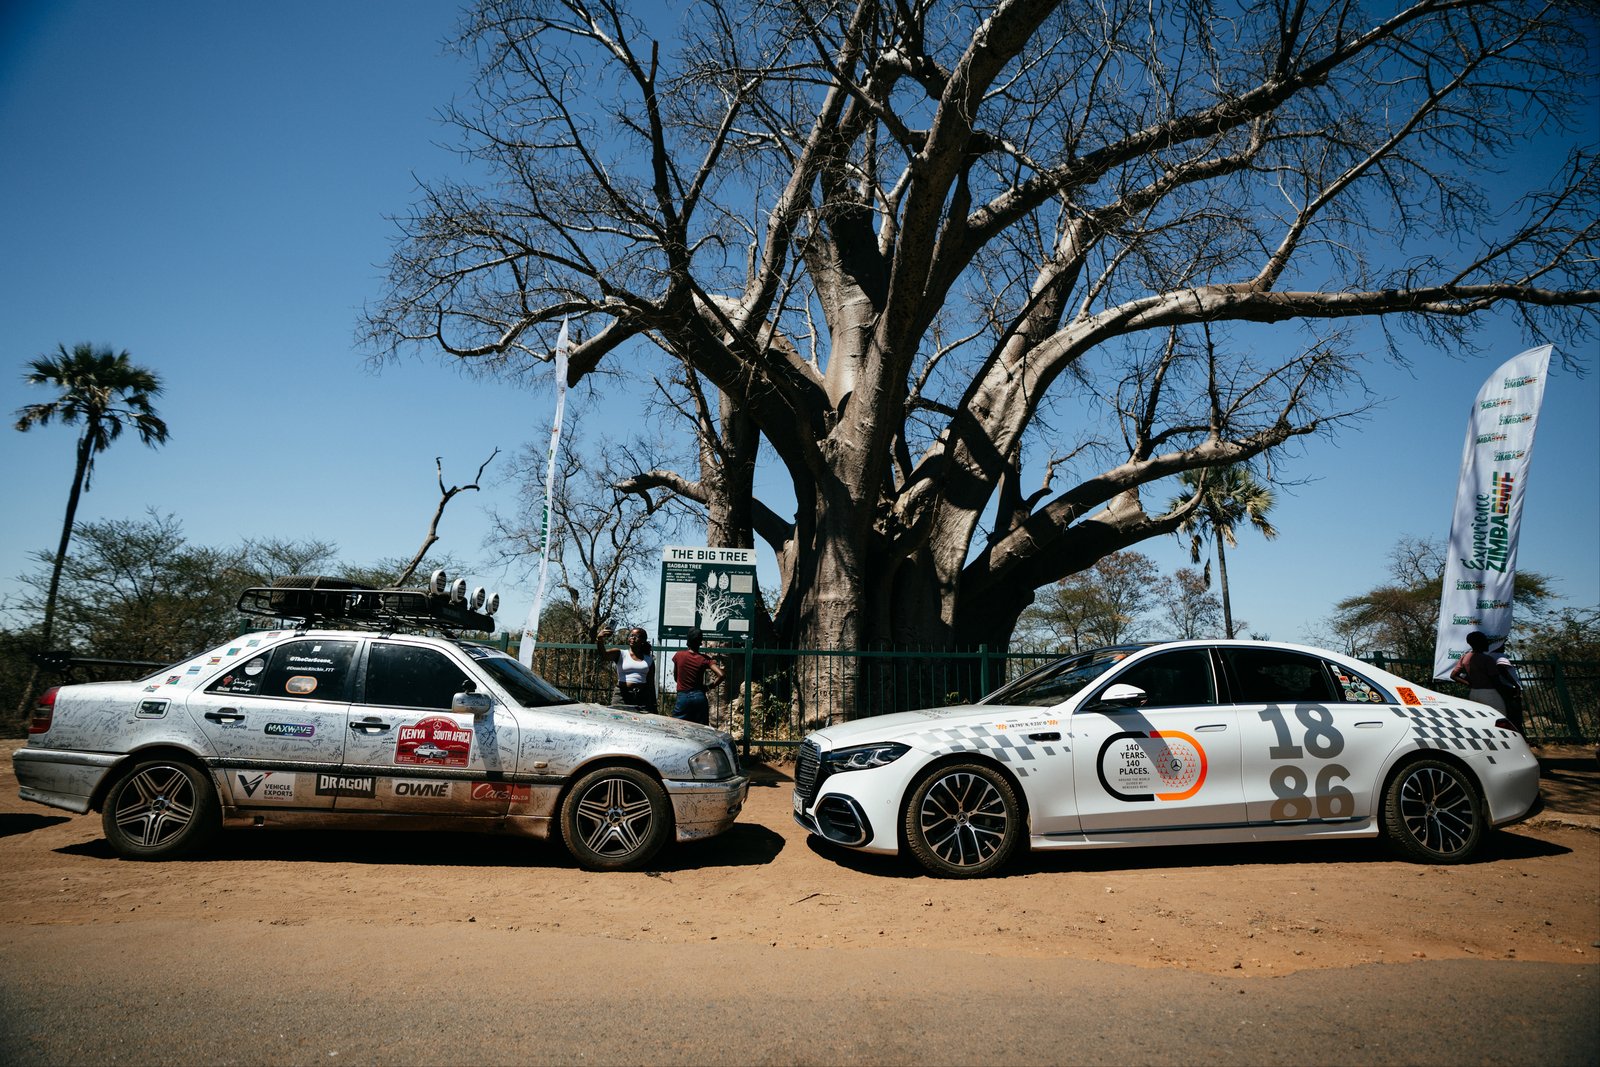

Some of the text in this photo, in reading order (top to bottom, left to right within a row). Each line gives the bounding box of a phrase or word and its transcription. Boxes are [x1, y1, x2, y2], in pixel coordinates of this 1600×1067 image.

[1485, 471, 1514, 573] ZIMBABWE
[1460, 492, 1492, 571] Experience
[671, 549, 748, 562] THE BIG TREE
[268, 723, 313, 735] MAXWAVE
[400, 728, 426, 741] KENYA
[433, 730, 451, 741] SOUTH
[452, 731, 471, 744] AFRICA
[1120, 751, 1147, 759] YEARS.
[1126, 759, 1140, 767] 140
[1119, 767, 1150, 775] PLACES.
[264, 783, 291, 791] VEHICLE
[320, 775, 372, 792] DRAGON
[395, 782, 449, 797] OWNÉ
